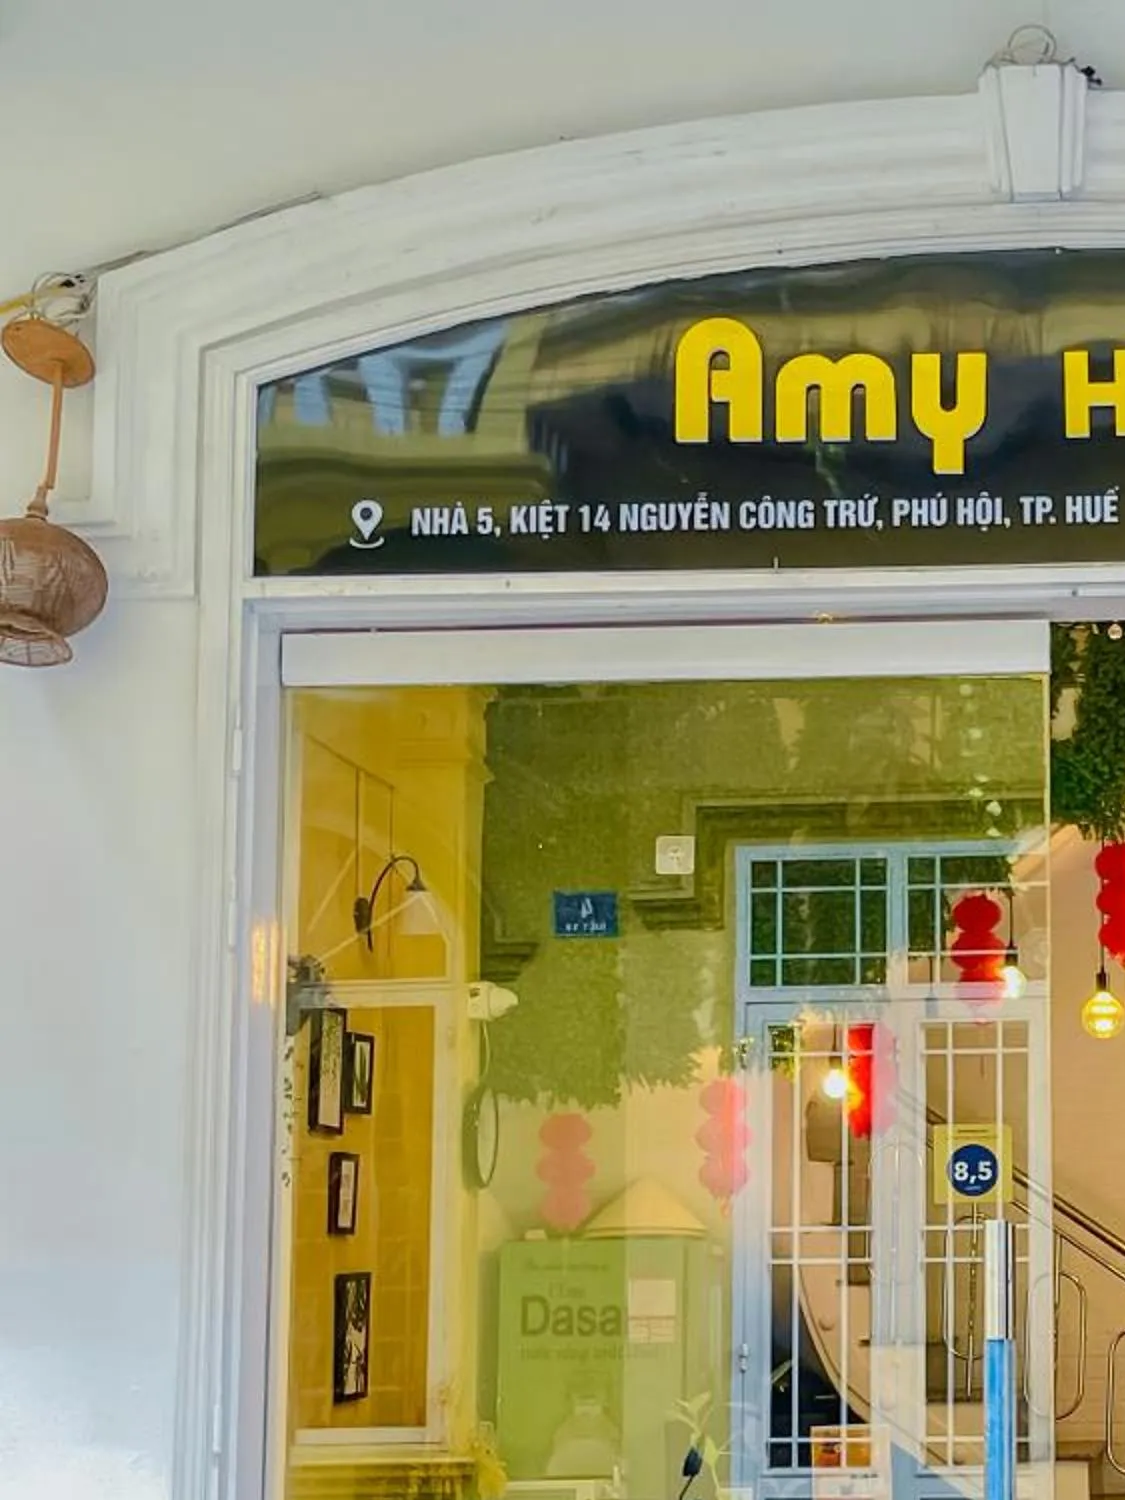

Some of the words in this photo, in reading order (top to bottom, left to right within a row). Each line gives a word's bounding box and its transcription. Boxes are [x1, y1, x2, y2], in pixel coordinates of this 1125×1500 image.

[411, 501, 469, 535] NHÀ
[477, 507, 501, 537] 5,
[510, 499, 569, 539] KIỆT
[579, 504, 612, 532] 14
[619, 491, 731, 532] NGUYỄN
[739, 496, 815, 530] CÔNG
[823, 493, 883, 531] TRỨ,
[892, 492, 947, 528] PHÚ
[957, 491, 1011, 532] HỘI,
[1019, 496, 1056, 525] TP.
[1065, 485, 1120, 524] HUẾ
[953, 1160, 993, 1185] 8,5
